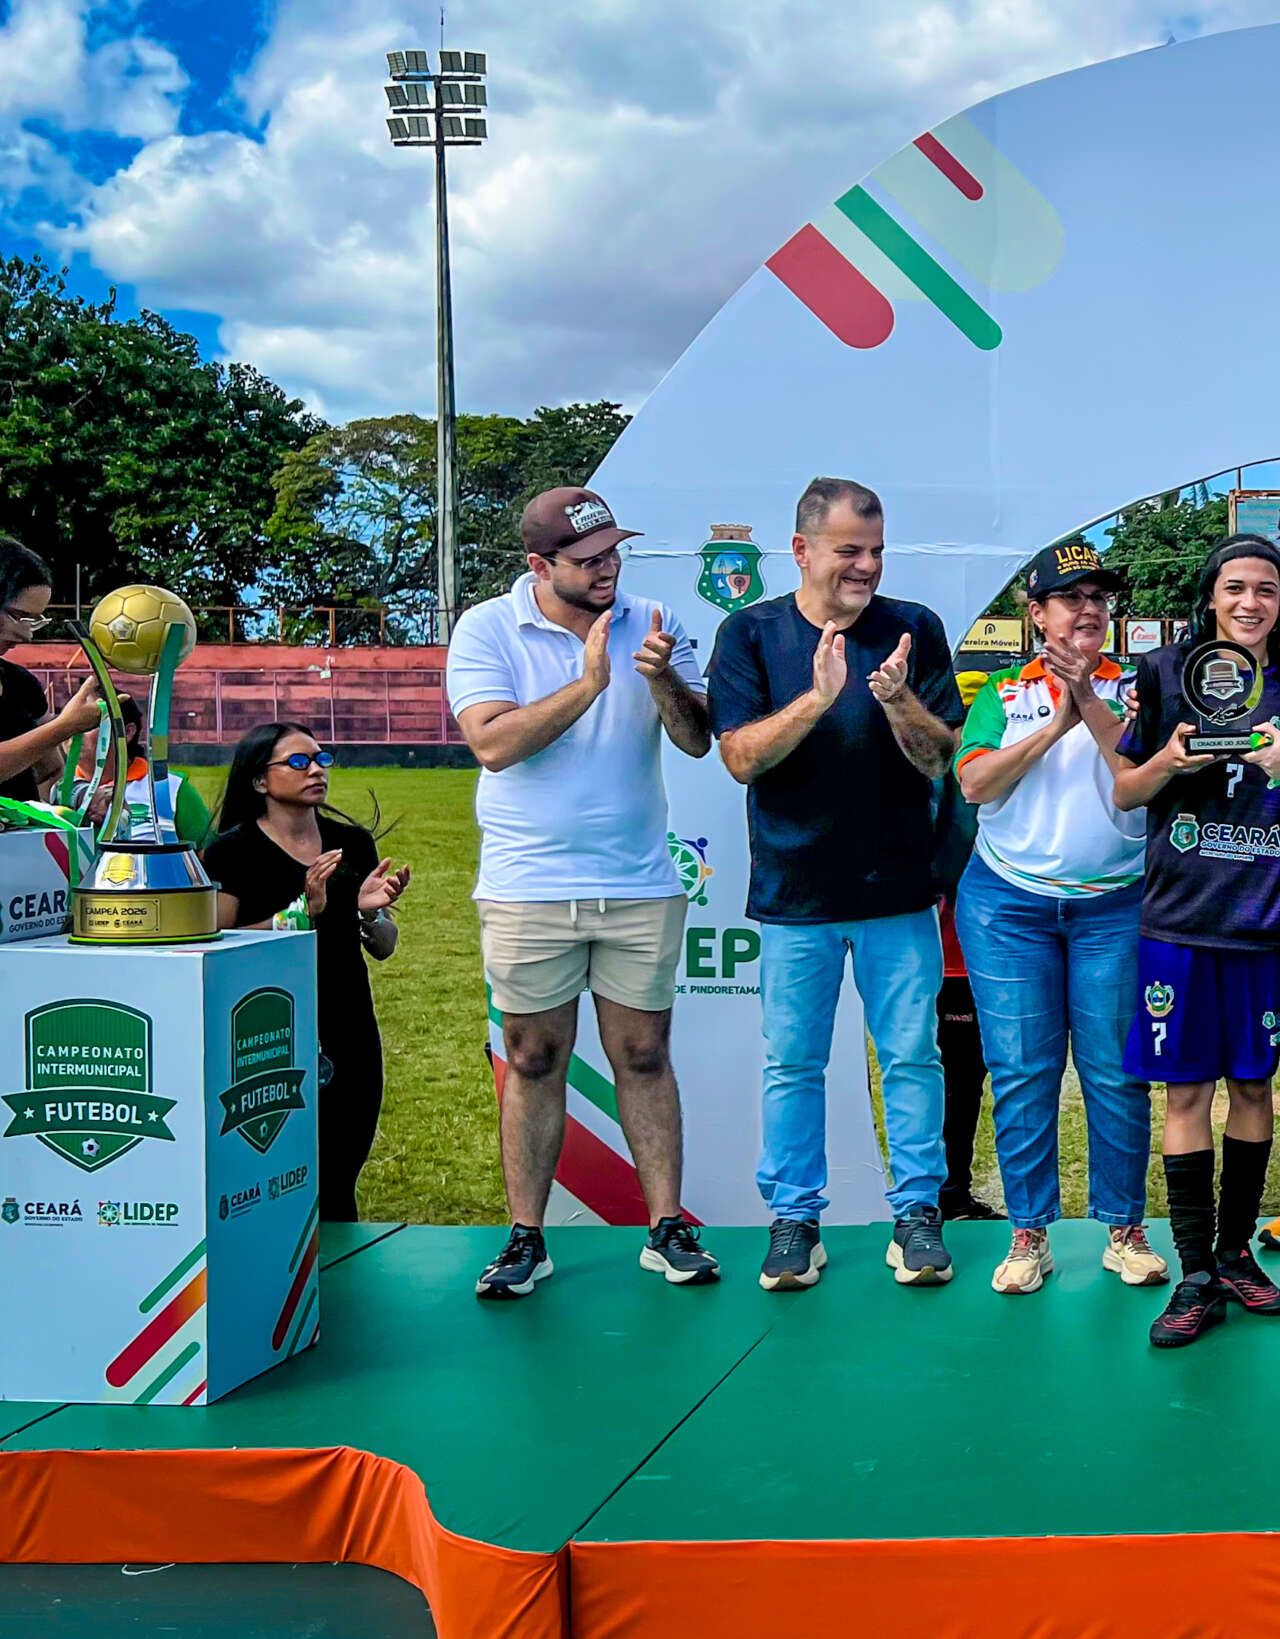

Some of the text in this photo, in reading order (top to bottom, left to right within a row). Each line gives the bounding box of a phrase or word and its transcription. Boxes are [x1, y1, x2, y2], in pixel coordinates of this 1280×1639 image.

[1055, 545, 1099, 564] LICAF
[991, 638, 1020, 647] Móveis
[1226, 763, 1244, 798] 7
[1201, 841, 1238, 851] GOVERNO
[1252, 847, 1280, 856] ESTADO
[9, 889, 66, 920] CEAR
[9, 920, 44, 933] GOVERNO
[45, 918, 55, 927] DO
[675, 985, 760, 995] DE PINDORETAMA
[237, 1026, 291, 1050] CAMPEONATO
[1152, 1022, 1167, 1056] 7
[36, 1045, 144, 1060] CAMPEONATO
[237, 1045, 290, 1068] INTERMUNICIPAL
[37, 1063, 142, 1077] INTERMUNICIPAL
[241, 1081, 290, 1113] FUTEBOL
[45, 1102, 143, 1124] FUTEBOL
[280, 1165, 308, 1191] LIDEP
[231, 1181, 261, 1207] CEARÁ
[24, 1199, 82, 1216] CEARÁ
[123, 1202, 179, 1221] LIDEP
